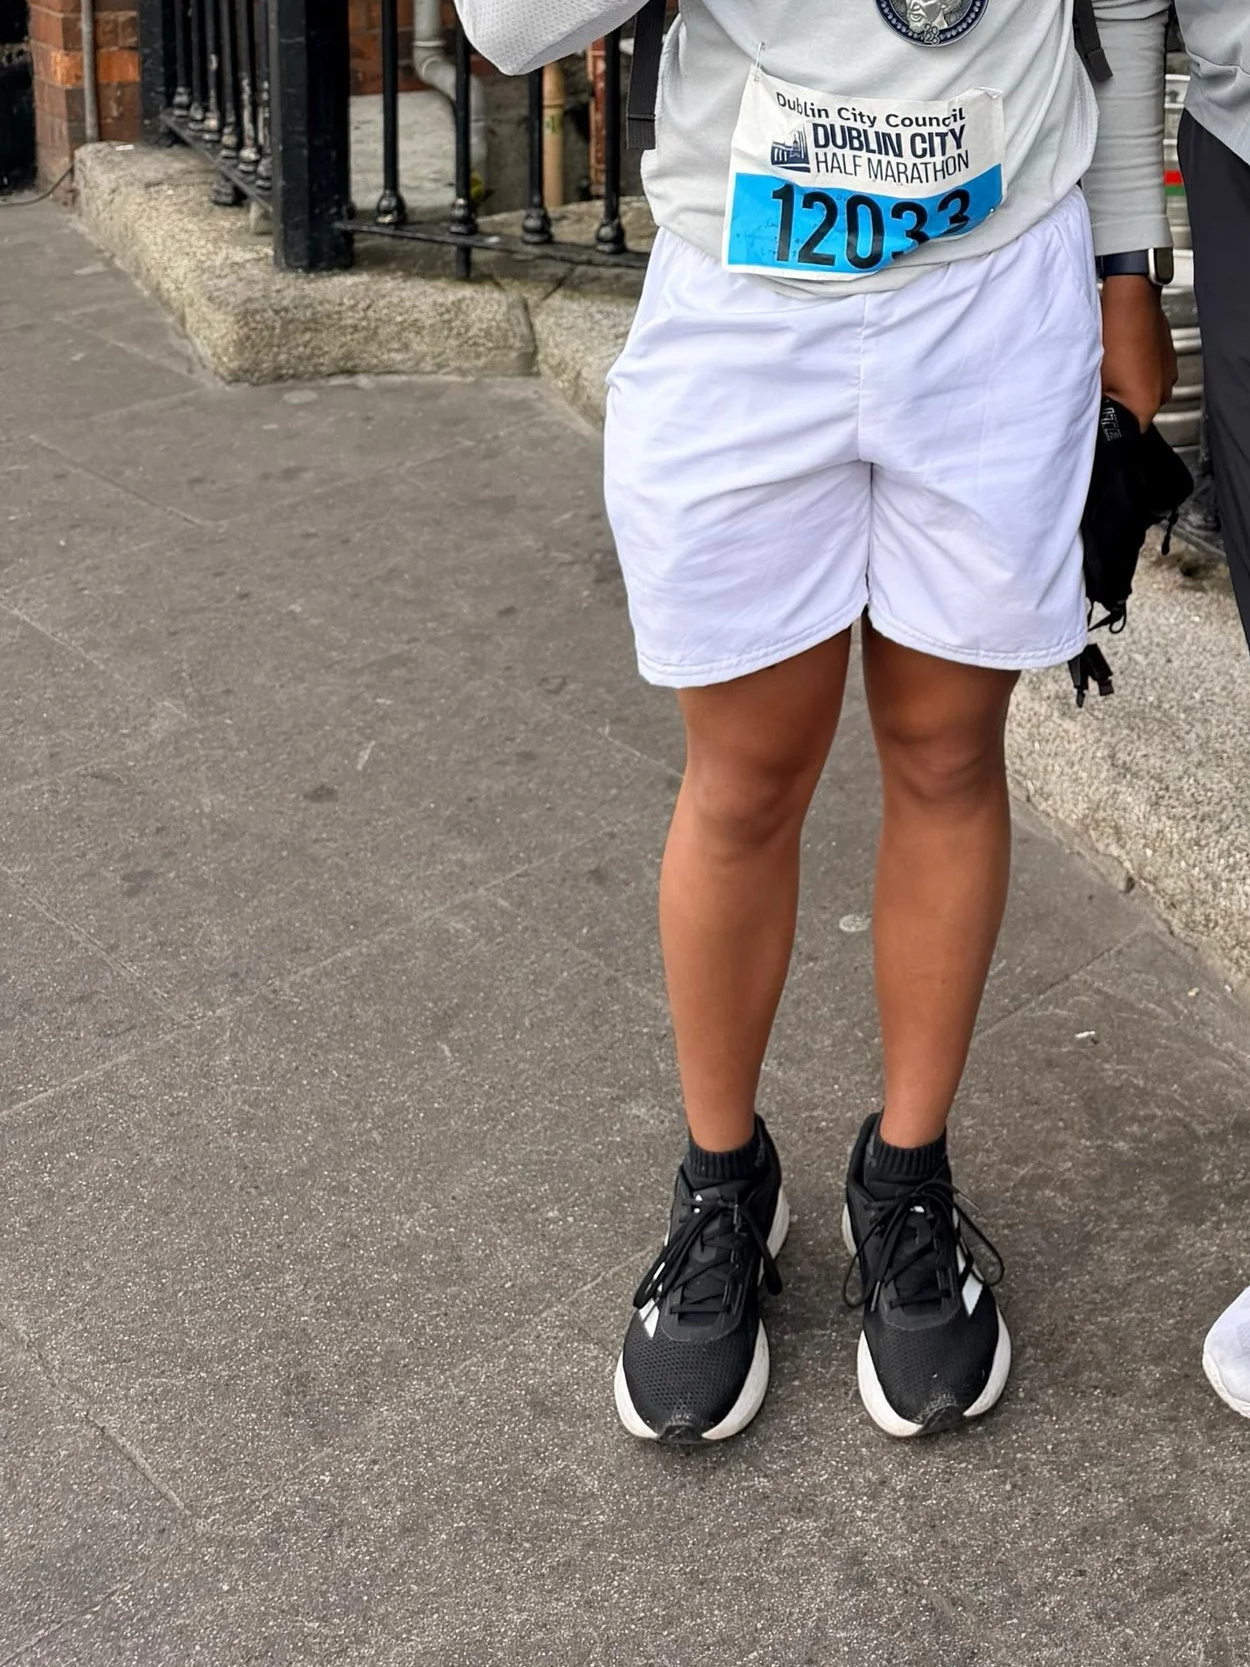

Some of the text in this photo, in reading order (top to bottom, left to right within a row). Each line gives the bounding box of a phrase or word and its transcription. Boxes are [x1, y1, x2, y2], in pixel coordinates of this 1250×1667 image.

[776, 91, 966, 129] Dublin City Council
[811, 122, 967, 159] DUBLIN CITY
[815, 149, 970, 186] HALF MARATHON
